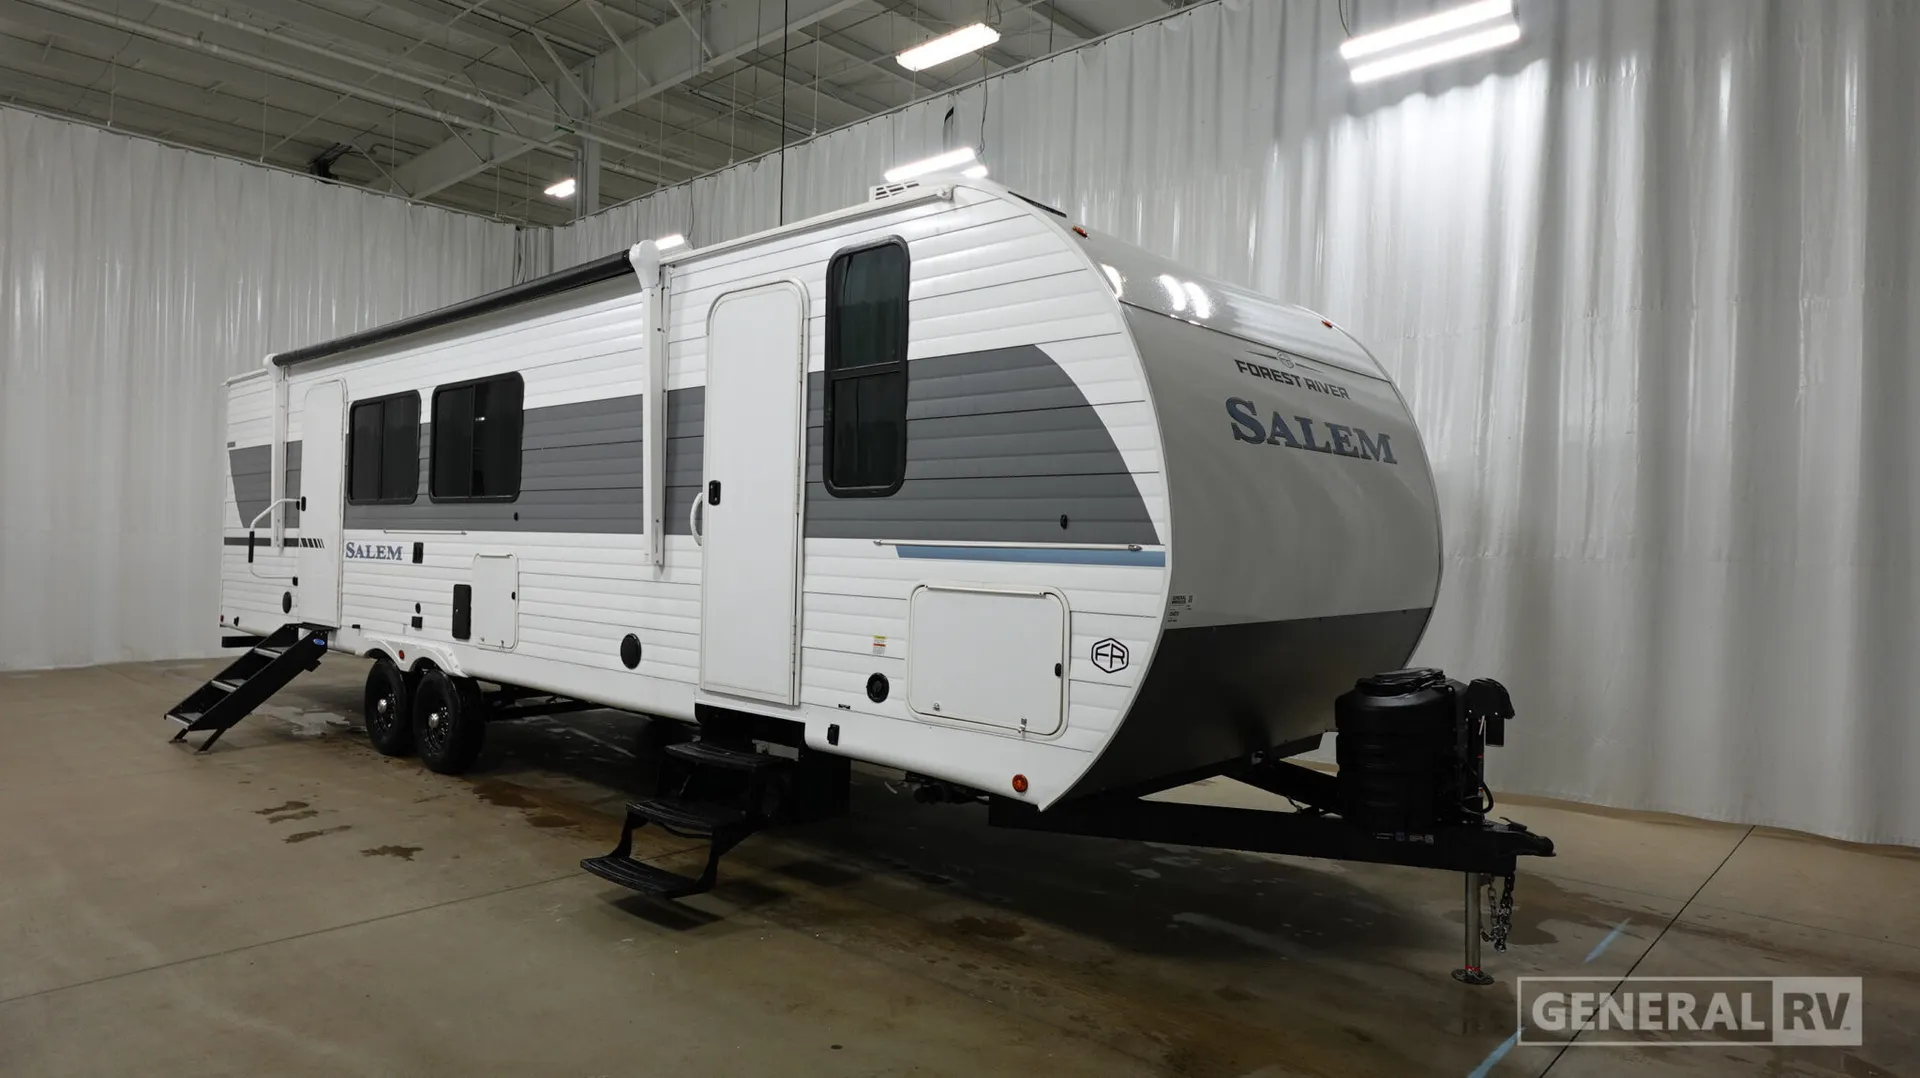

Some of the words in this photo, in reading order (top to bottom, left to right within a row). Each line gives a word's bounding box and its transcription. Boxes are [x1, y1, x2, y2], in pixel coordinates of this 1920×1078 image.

[1234, 359, 1301, 388] FOREST
[1303, 381, 1351, 399] RIVER
[1225, 396, 1398, 464] SALEM
[345, 541, 403, 561] SALEM
